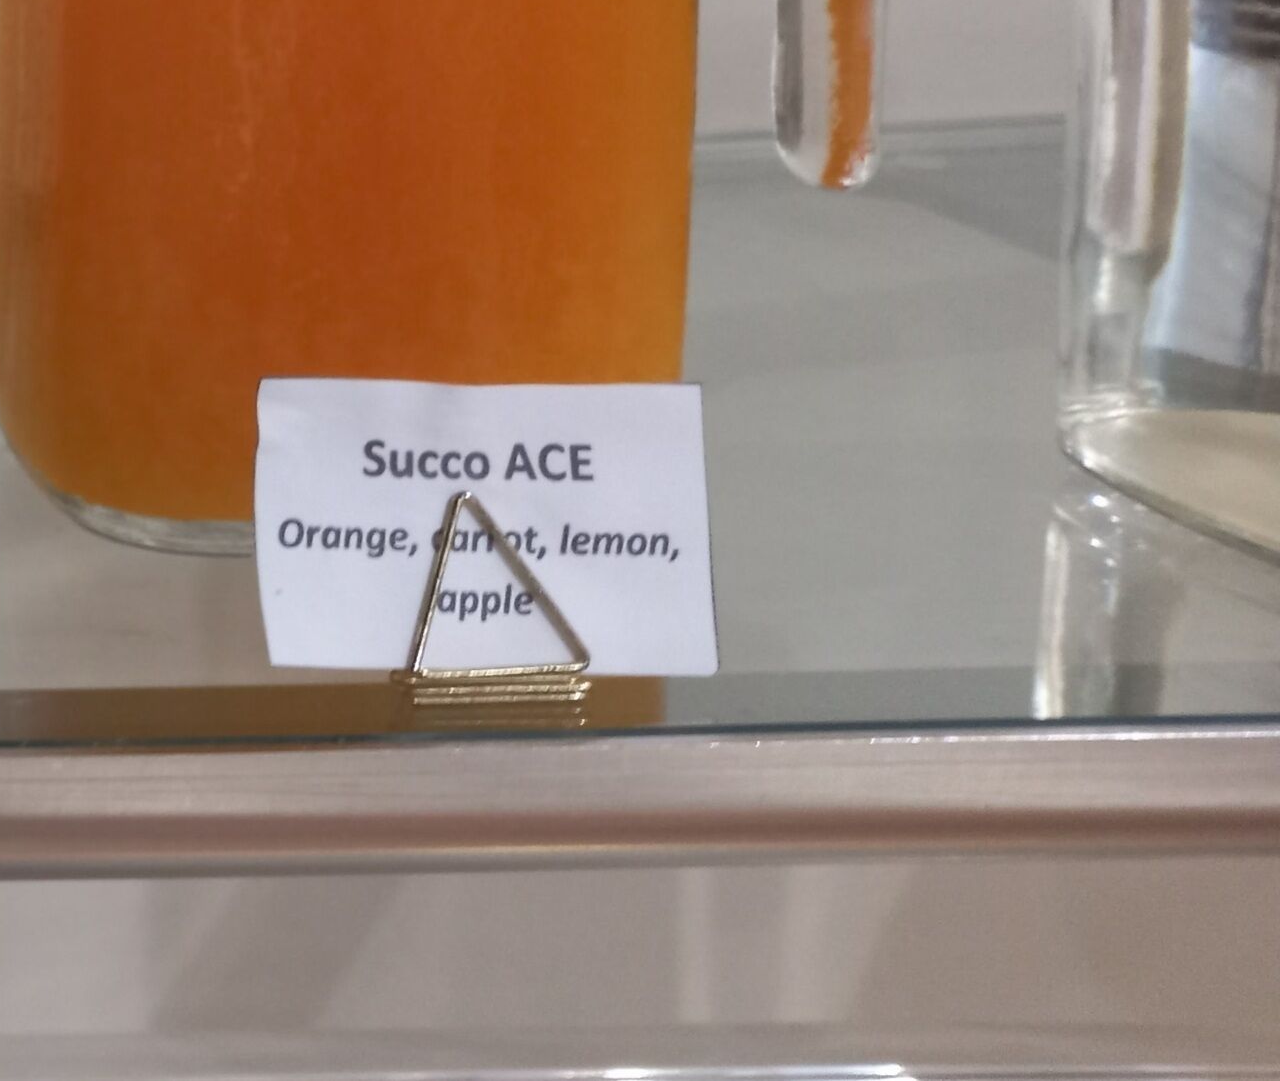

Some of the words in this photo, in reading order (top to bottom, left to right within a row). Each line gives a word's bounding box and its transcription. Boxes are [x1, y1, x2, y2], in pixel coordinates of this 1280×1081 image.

[363, 439, 490, 480] Succo
[504, 443, 594, 481] ACE
[278, 518, 419, 558] Orange,
[560, 524, 680, 562] lemon,
[437, 583, 535, 621] apple
